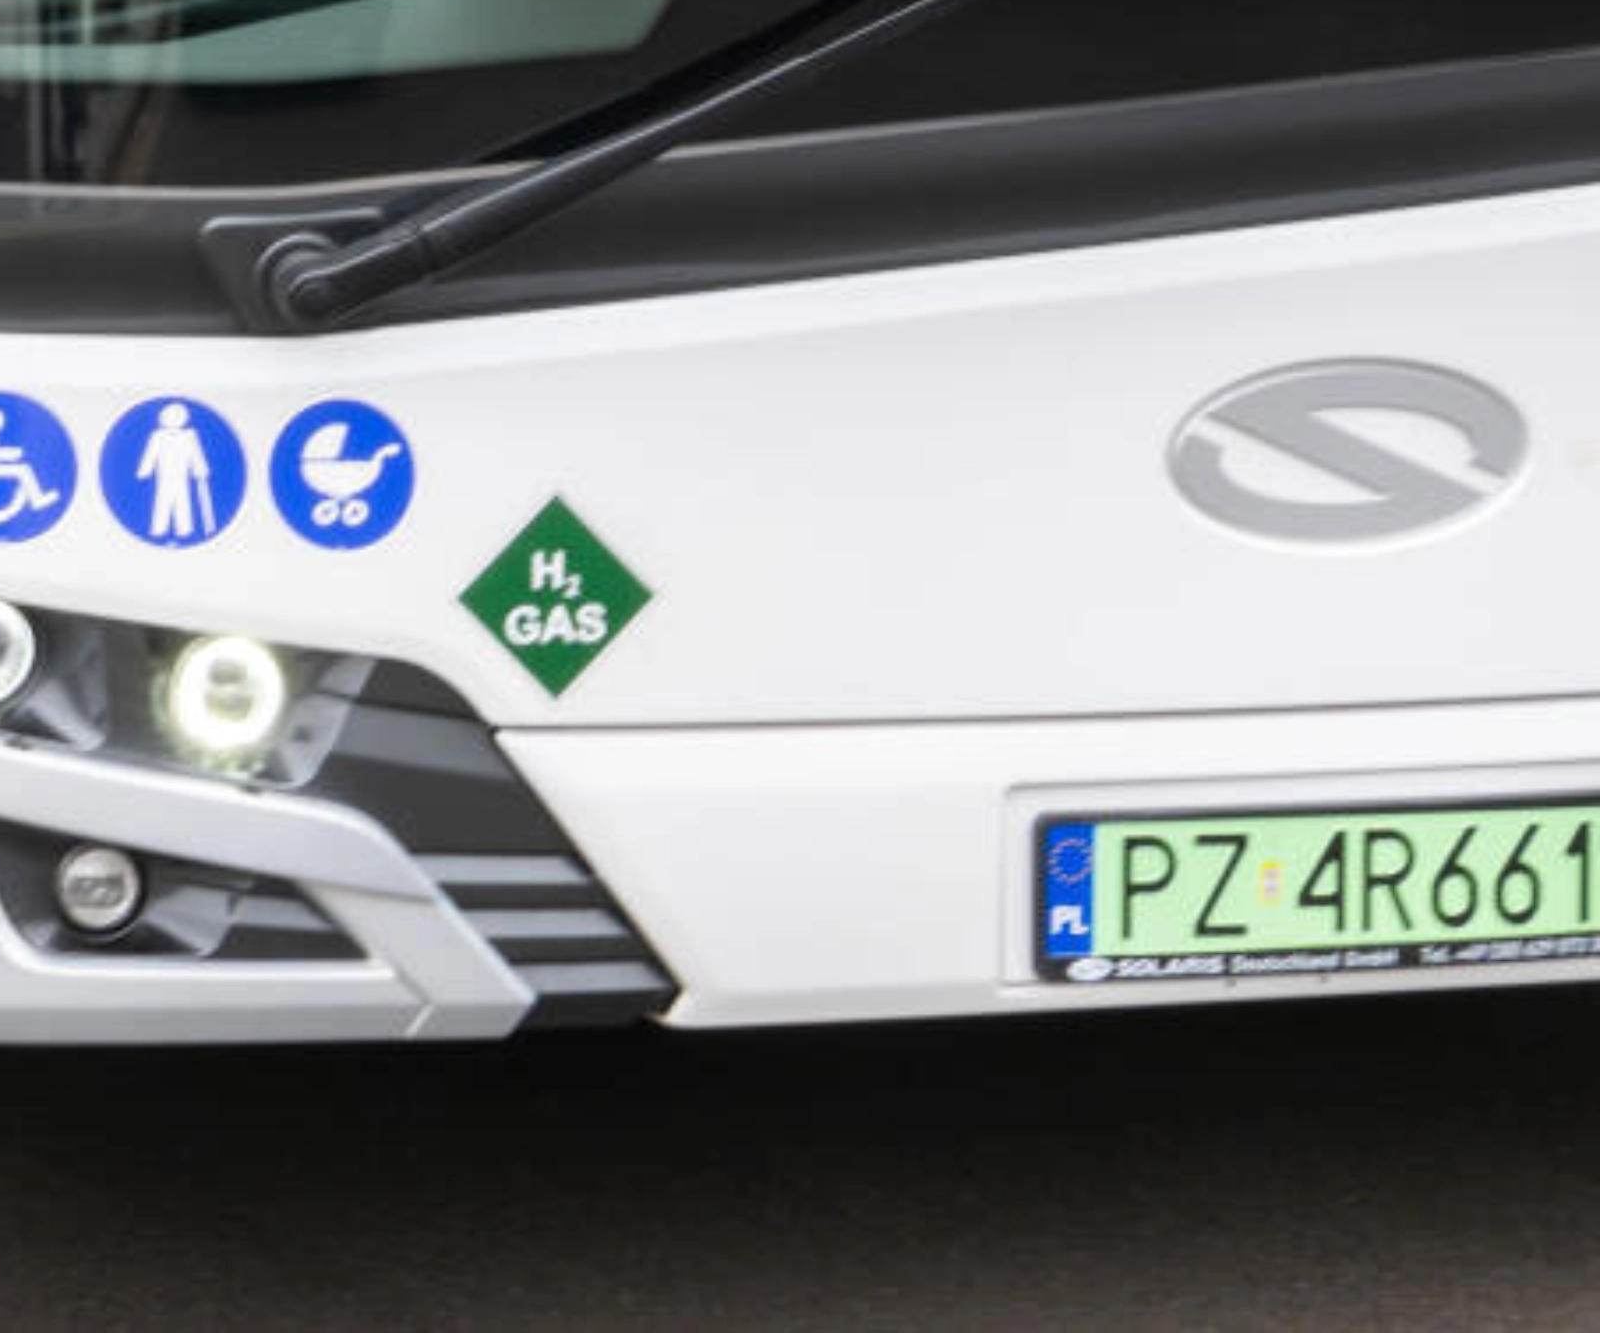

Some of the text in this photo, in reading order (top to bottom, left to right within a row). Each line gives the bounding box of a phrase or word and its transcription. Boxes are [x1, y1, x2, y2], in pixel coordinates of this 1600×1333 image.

[503, 602, 609, 646] GAS
[1121, 822, 1590, 940] PZ 4R661
[1048, 905, 1089, 935] PL
